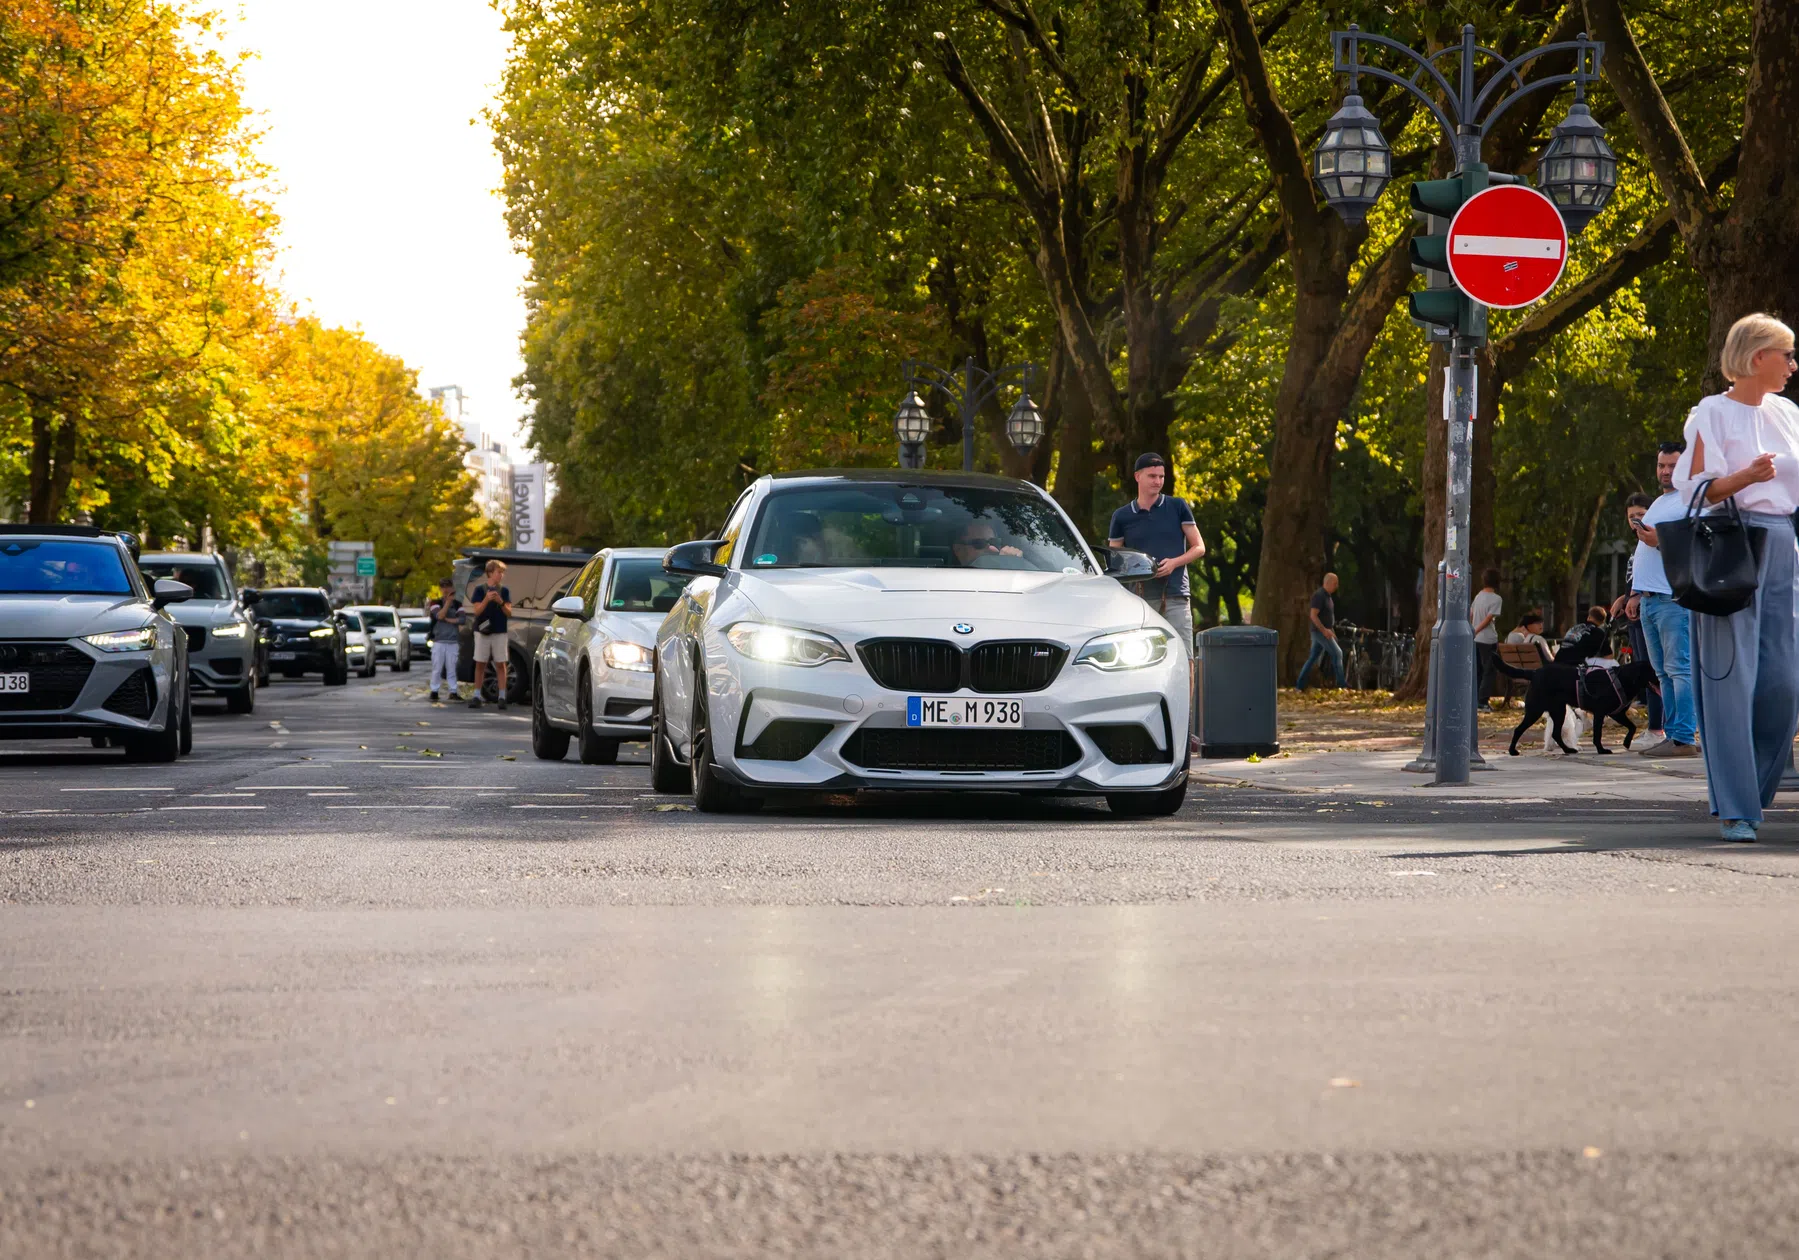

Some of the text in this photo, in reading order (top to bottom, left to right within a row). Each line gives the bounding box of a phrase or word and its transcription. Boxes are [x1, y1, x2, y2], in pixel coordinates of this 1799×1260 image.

[8, 675, 27, 690] 38
[922, 700, 948, 723] ME
[965, 701, 978, 723] M
[984, 701, 1021, 724] 938
